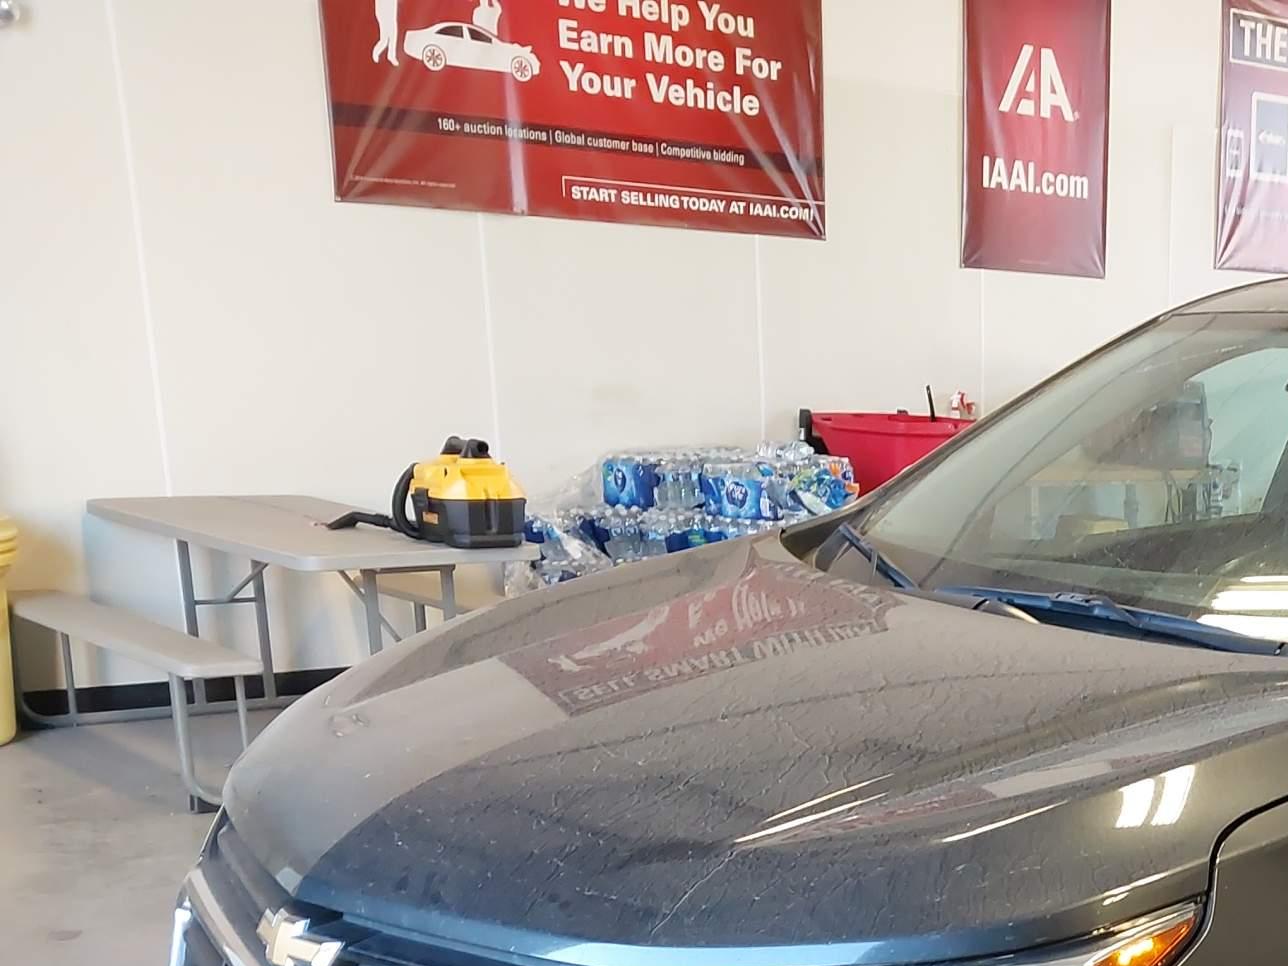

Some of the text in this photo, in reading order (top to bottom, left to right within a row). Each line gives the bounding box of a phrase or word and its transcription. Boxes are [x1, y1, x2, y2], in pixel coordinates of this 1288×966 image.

[697, 1, 755, 38] You
[1240, 18, 1288, 63] THE
[558, 18, 782, 81] Earn More For
[560, 60, 760, 117] Your Vehicle
[437, 117, 460, 131] 160+
[464, 122, 502, 136] auction
[505, 126, 546, 141] locations
[555, 130, 585, 145] Global
[587, 137, 629, 151] customer
[632, 140, 653, 153] base
[660, 143, 711, 160] Competitive
[713, 149, 745, 166] bidding
[982, 155, 1088, 199] IAAI.com
[571, 185, 617, 203] START
[621, 190, 679, 209] SELLING
[680, 196, 725, 213] TODAY
[729, 199, 746, 215] AT
